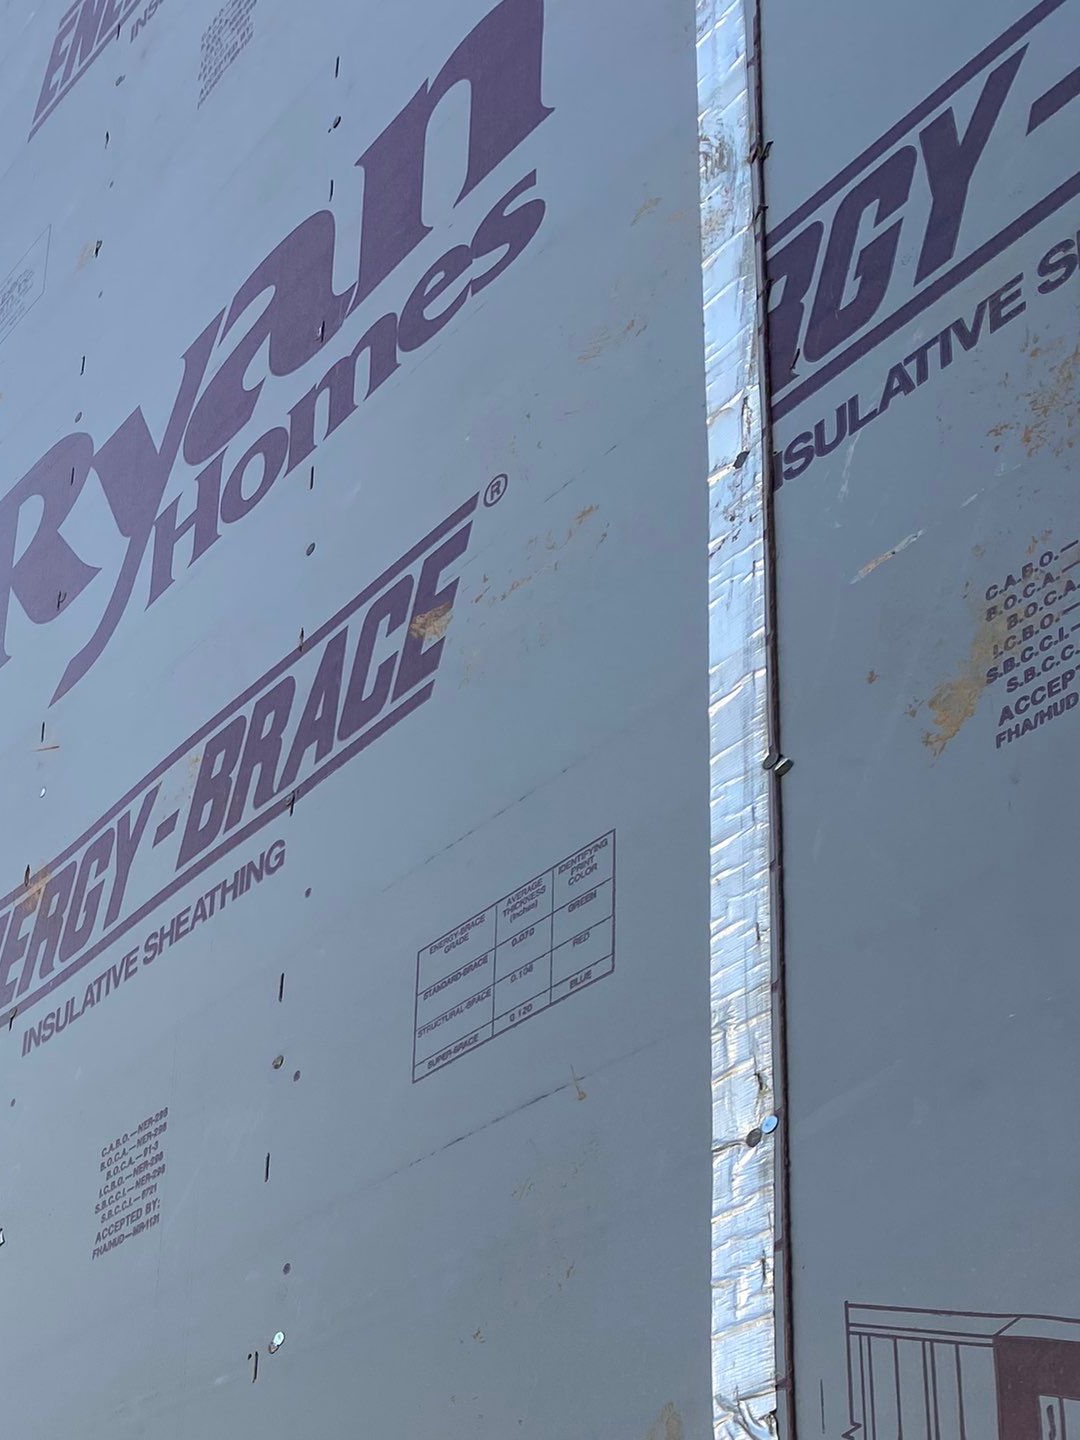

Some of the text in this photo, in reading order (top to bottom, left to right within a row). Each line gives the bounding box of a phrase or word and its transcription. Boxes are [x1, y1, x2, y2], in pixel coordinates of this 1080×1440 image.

[145, 169, 545, 611] Homes
[998, 664, 1080, 727] ACCEP
[22, 839, 286, 1057] INSULATIVE SHEATHING
[429, 913, 486, 955] ENERGY-BRACE
